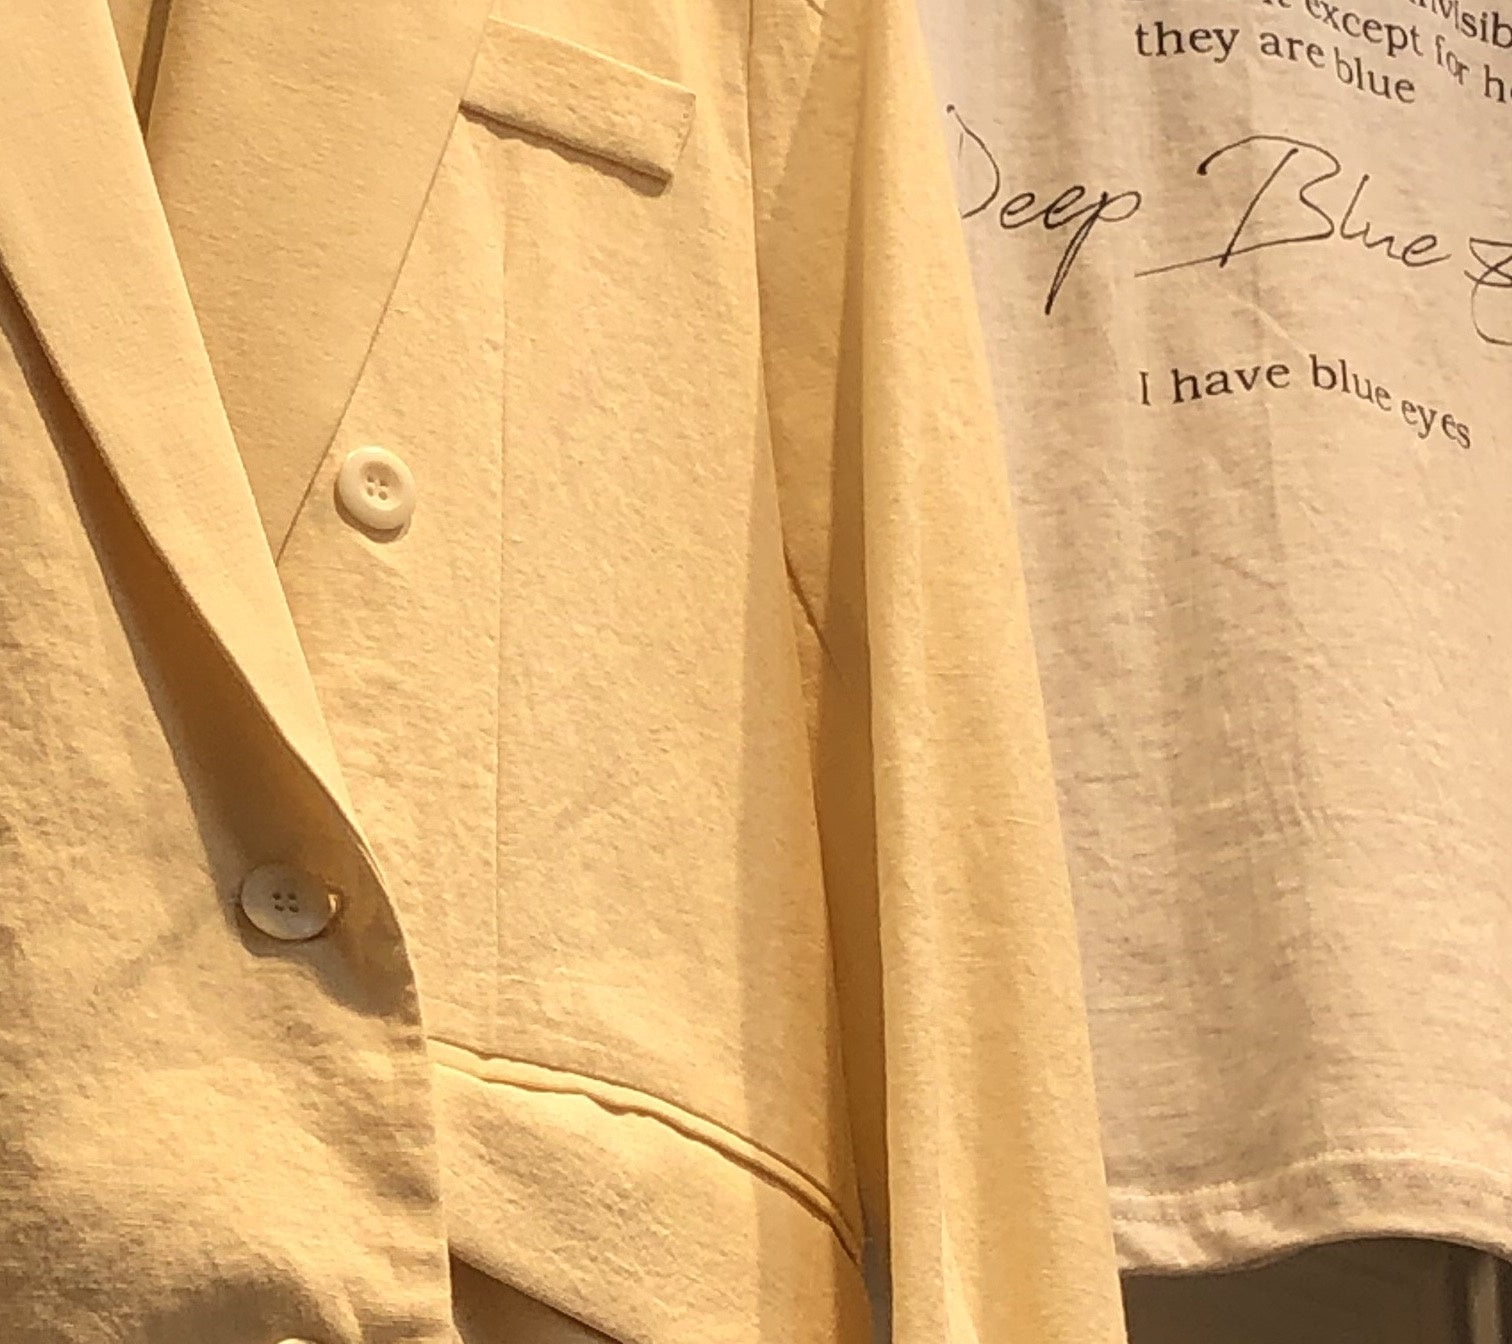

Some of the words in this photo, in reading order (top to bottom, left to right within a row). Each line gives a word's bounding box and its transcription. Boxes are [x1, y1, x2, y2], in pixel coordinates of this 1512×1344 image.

[1135, 21, 1240, 63] they
[1260, 31, 1325, 68] are
[1334, 47, 1416, 103] blue
[1435, 35, 1470, 85] for
[1484, 64, 1512, 103] h
[1134, 135, 1451, 278] Blue
[1139, 371, 1150, 406] I
[1171, 362, 1290, 404] have
[1309, 354, 1392, 411] blue
[1401, 398, 1472, 449] eyes
